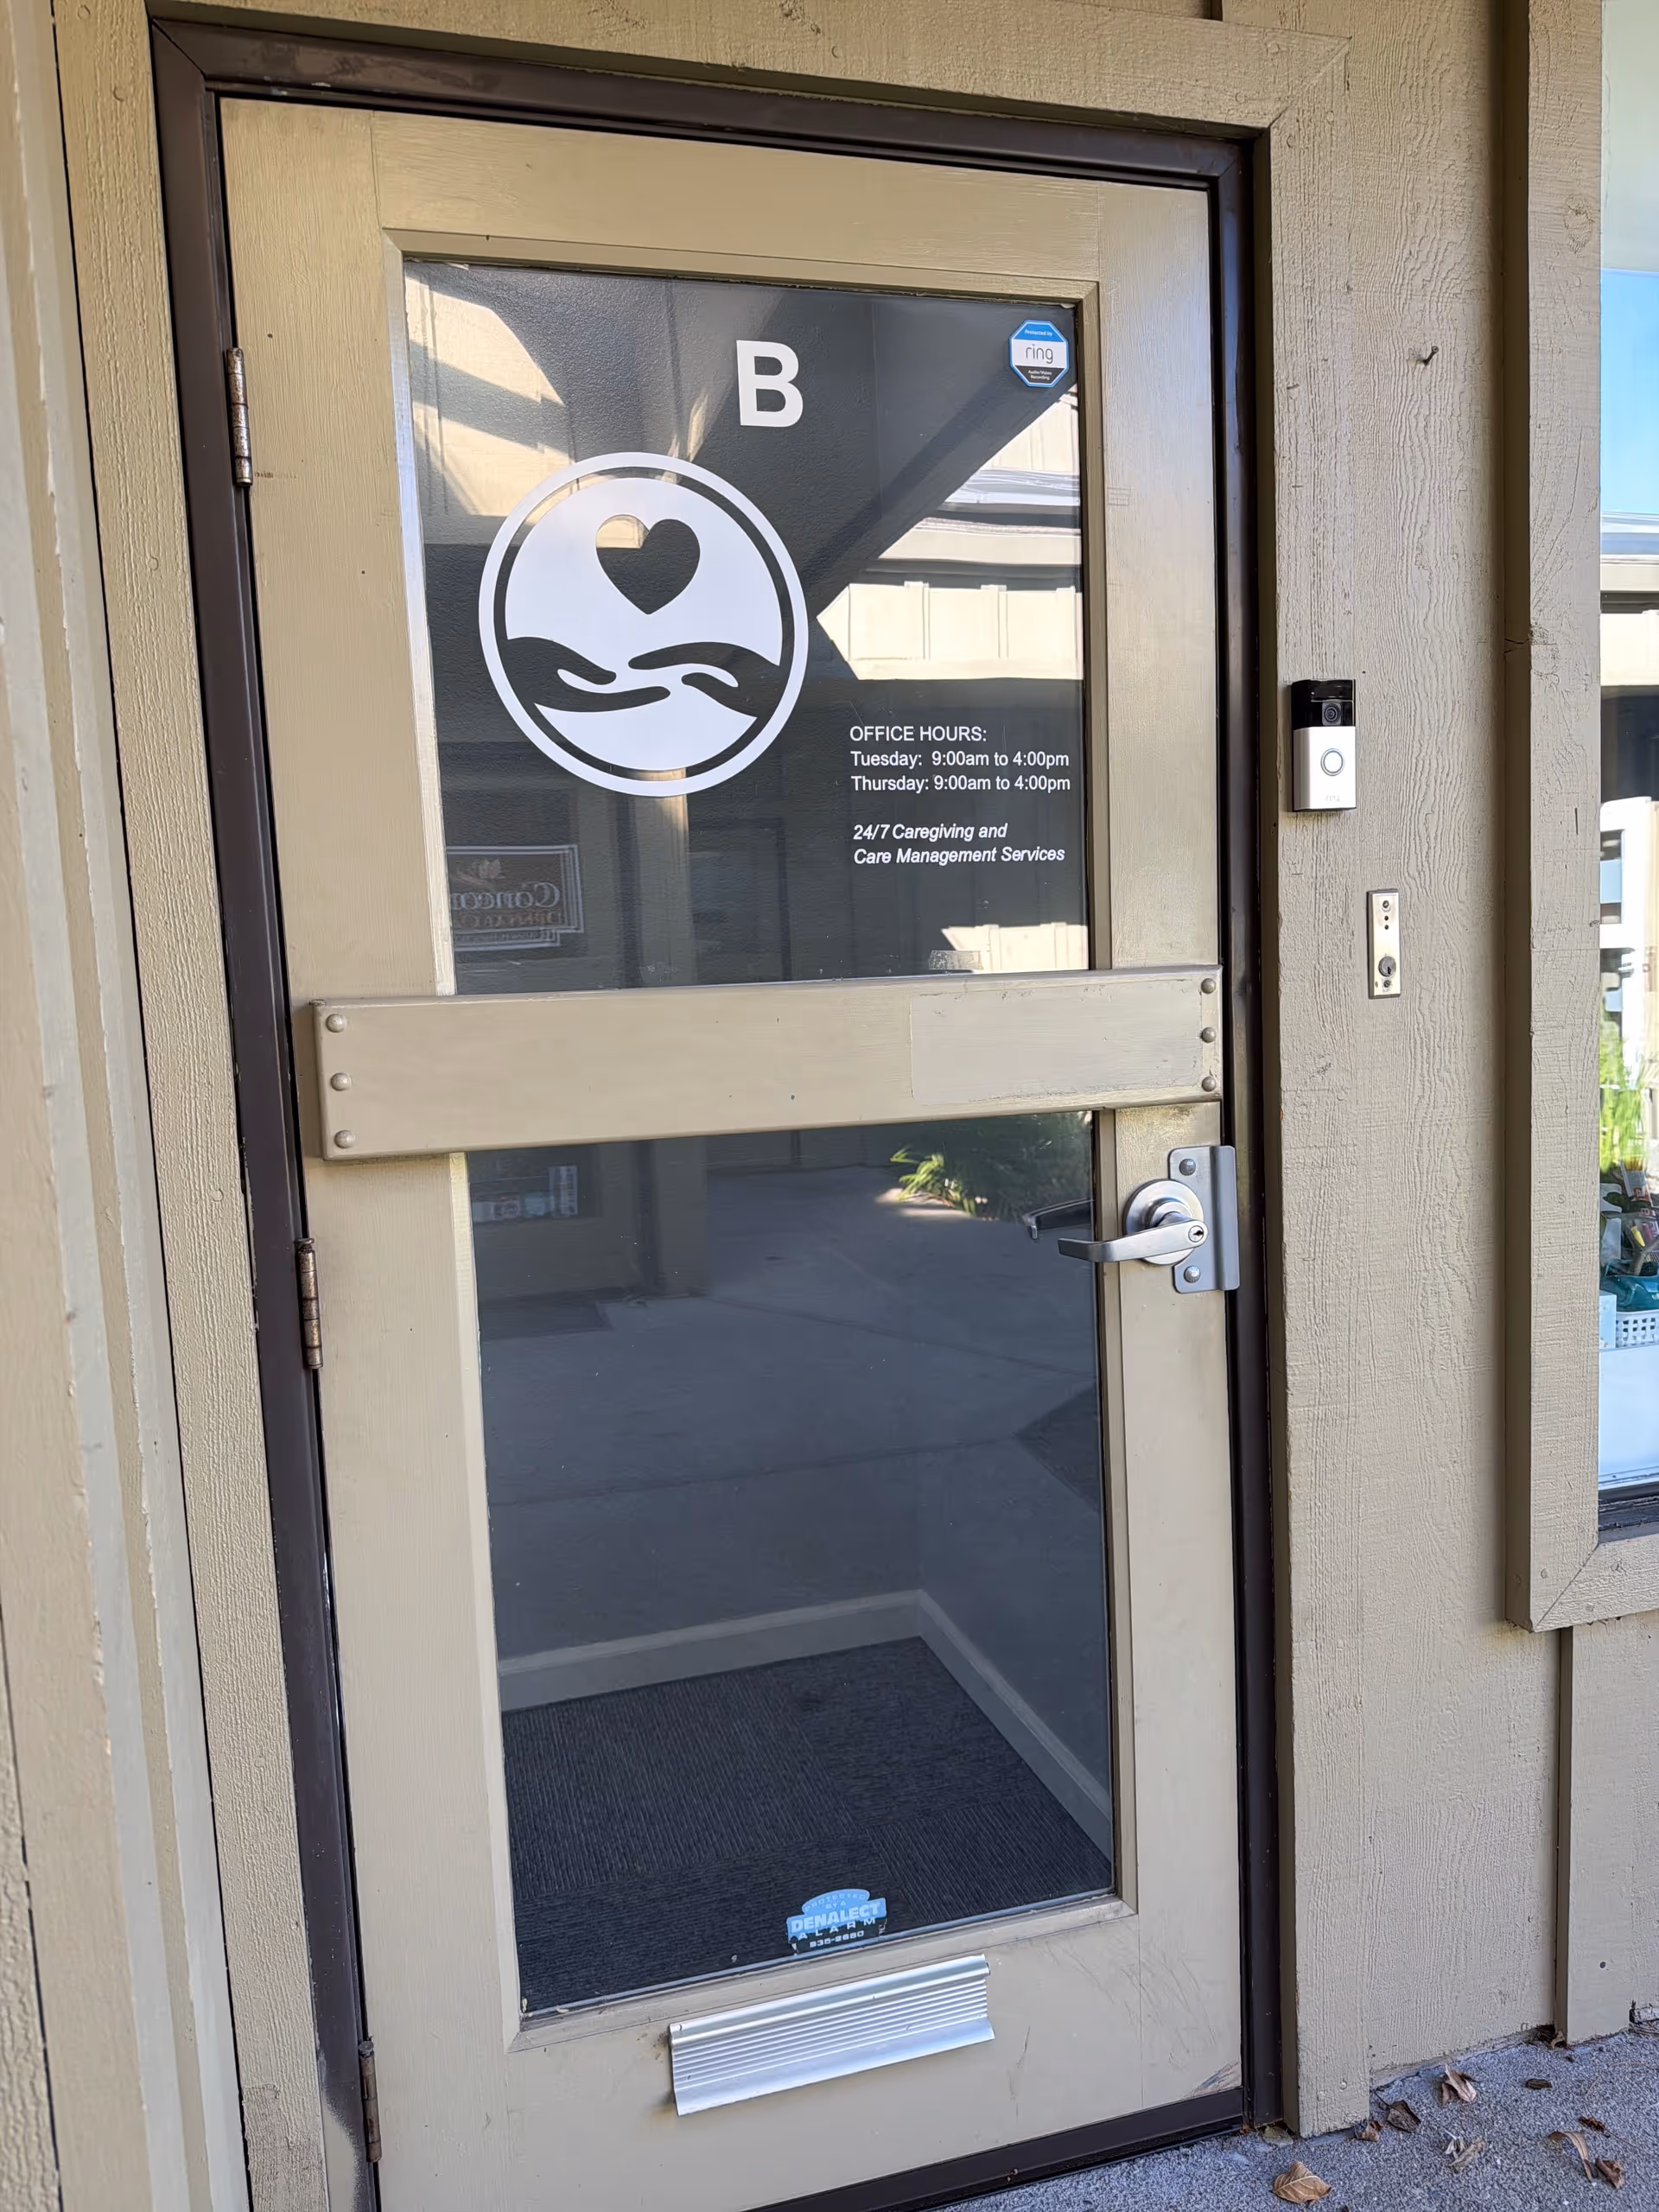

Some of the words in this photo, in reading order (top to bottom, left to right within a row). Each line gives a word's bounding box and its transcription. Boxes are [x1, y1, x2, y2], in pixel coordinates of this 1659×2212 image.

[1026, 344, 1053, 365] ring
[736, 340, 803, 427] B
[850, 726, 914, 741] OFFICE
[920, 726, 986, 741] HOURS:
[850, 751, 922, 769] Tuesday:
[932, 751, 988, 766] 9:00am
[994, 753, 1008, 766] to
[1013, 751, 1069, 769] 4:00pm
[851, 776, 928, 793] Thursday:
[934, 775, 990, 790] 9:00am
[995, 776, 1010, 790] to
[1014, 775, 1070, 793] 4:00pm
[854, 824, 890, 839] 24/7
[893, 823, 974, 842] Caregiving
[979, 823, 1007, 837] and
[855, 849, 891, 864] Care
[896, 848, 997, 866] Management
[1001, 847, 1065, 861] Services
[804, 1893, 866, 1913] PROTECTED
[791, 1902, 880, 1933] DENALECT
[798, 1916, 875, 1941] ALARM
